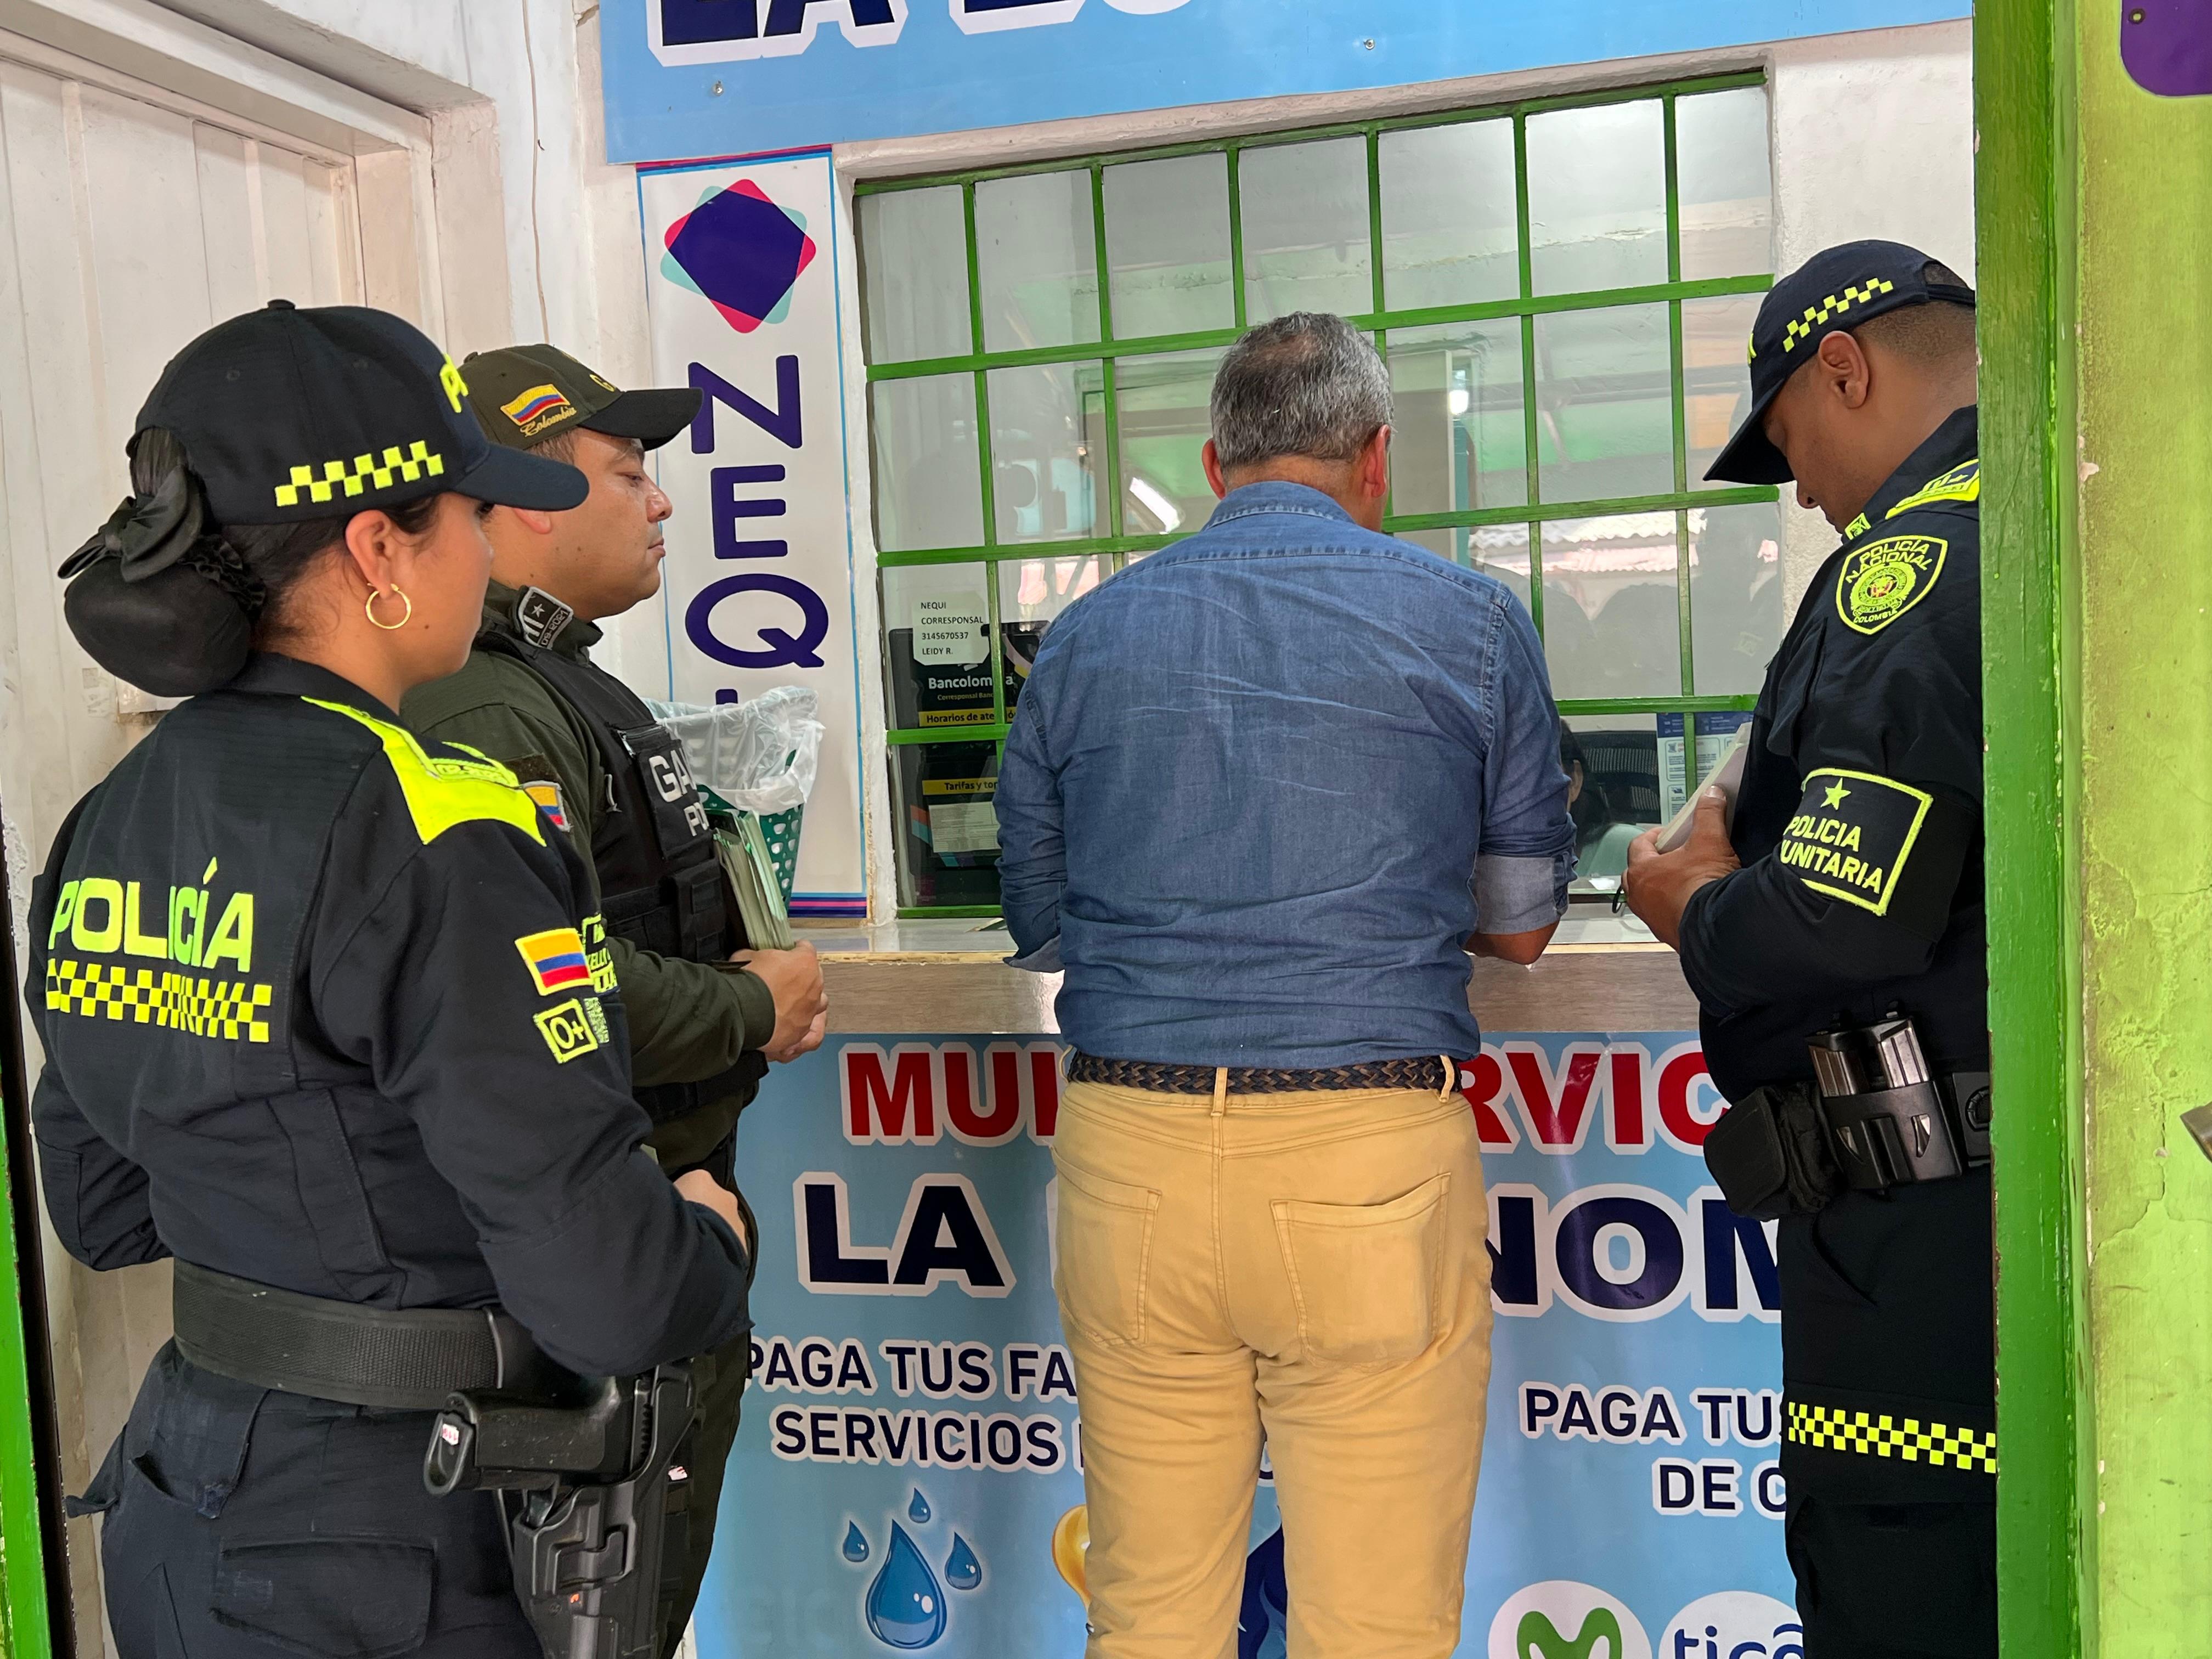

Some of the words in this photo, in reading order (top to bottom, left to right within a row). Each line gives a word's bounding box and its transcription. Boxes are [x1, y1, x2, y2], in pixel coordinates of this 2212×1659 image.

[520, 405, 577, 437] Colombia
[685, 354, 829, 706] NEQ
[1845, 551, 1933, 583] NACIONAL
[921, 602, 947, 610] NEQUI
[921, 616, 984, 624] CORRESPONSAL
[1853, 608, 1898, 623] COLOMBIA
[937, 692, 978, 701] Corresponsal
[926, 713, 965, 723] Horarios
[966, 713, 978, 721] de
[944, 782, 975, 791] Tarifas
[977, 782, 982, 791] y
[1782, 815, 1861, 852] POLICIA
[48, 856, 254, 973] POLICÍA
[804, 1184, 1006, 1287] LA
[885, 1346, 988, 1394] TUS
[1525, 1387, 1680, 1438] PAGA
[775, 1410, 1059, 1468] SERVICIOS
[1659, 1464, 1735, 1510] DE
